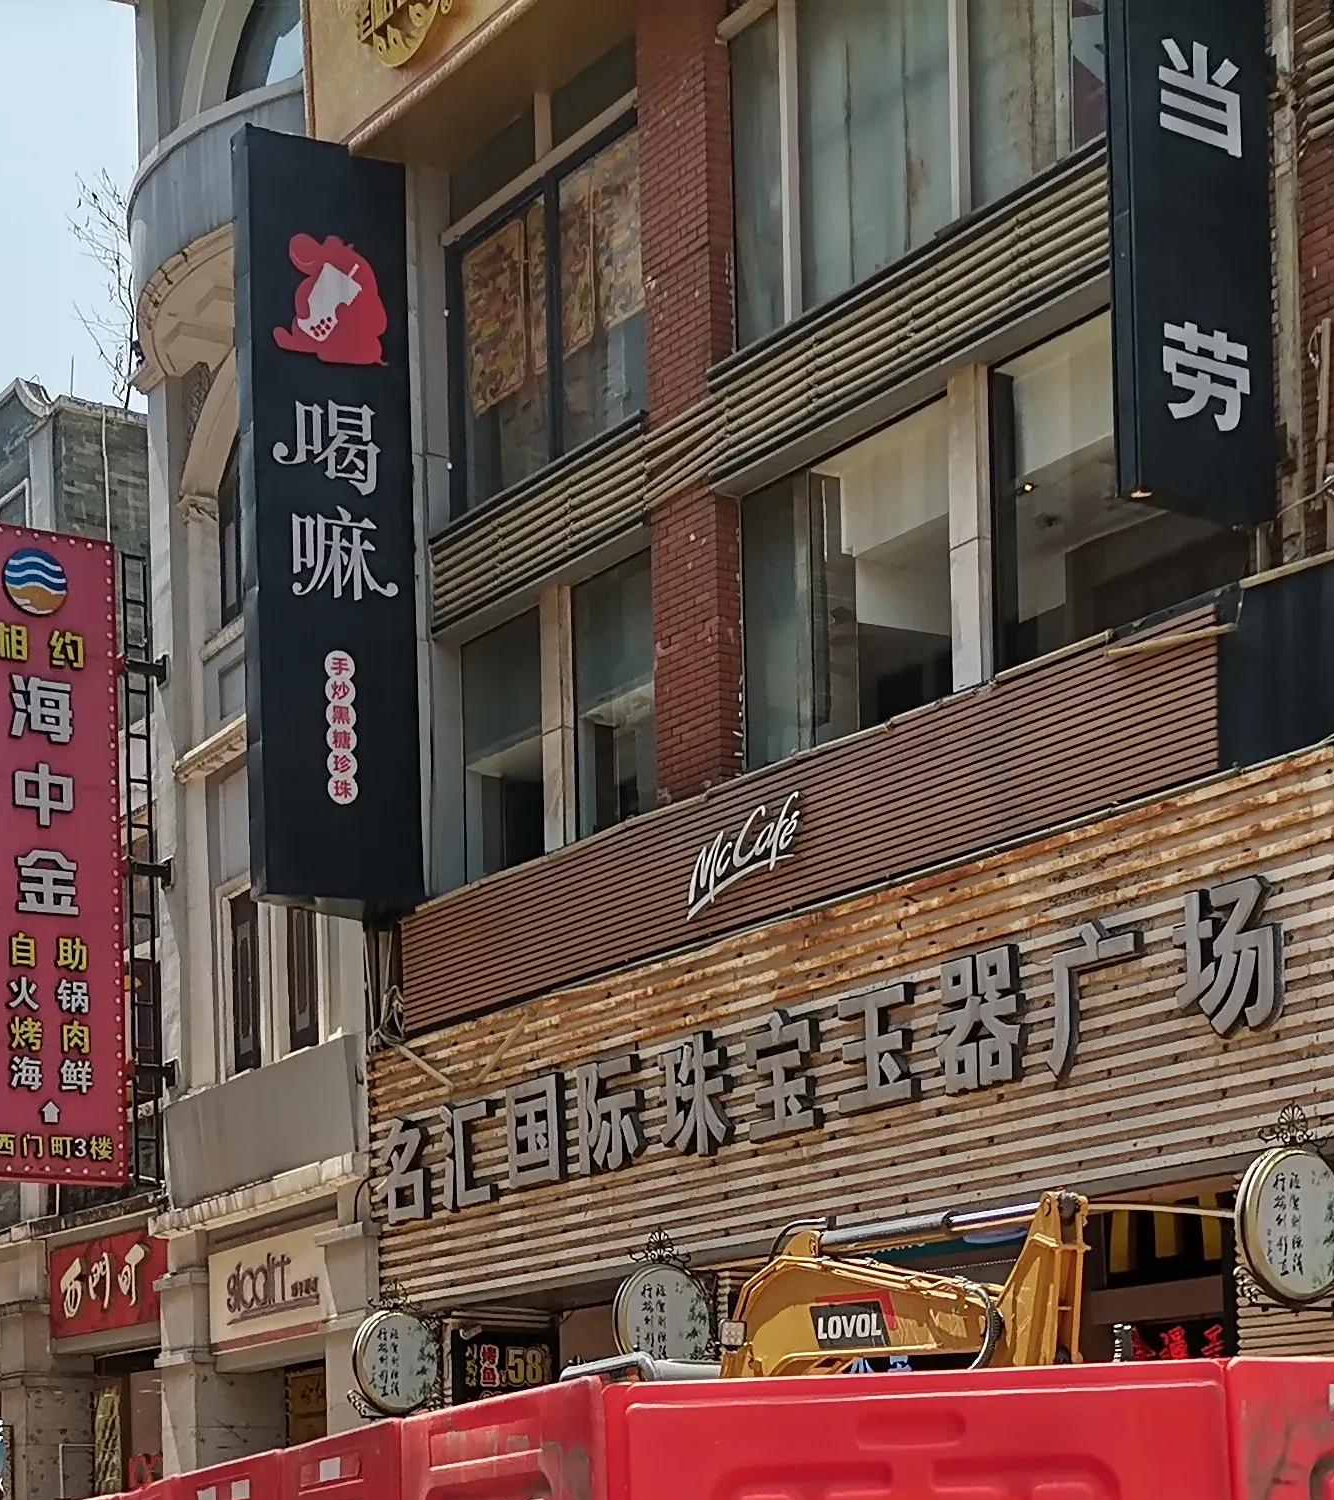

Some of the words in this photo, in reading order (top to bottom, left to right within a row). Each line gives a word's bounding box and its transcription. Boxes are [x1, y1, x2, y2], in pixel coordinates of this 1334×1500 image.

[1158, 37, 1251, 433] 当劳
[272, 399, 399, 602] 喝嘛
[329, 655, 354, 802] 手炒黑糖珍珠
[10, 674, 80, 917] 海中金
[687, 791, 800, 920] McCafé
[9, 932, 88, 971] 自助
[9, 976, 89, 1014] 火锅
[10, 1016, 90, 1055] 烤肉
[10, 1056, 94, 1094] 海鲜
[377, 876, 1286, 1225] 名汇国际珠宝玉器广场
[816, 1312, 882, 1340] LOVOL
